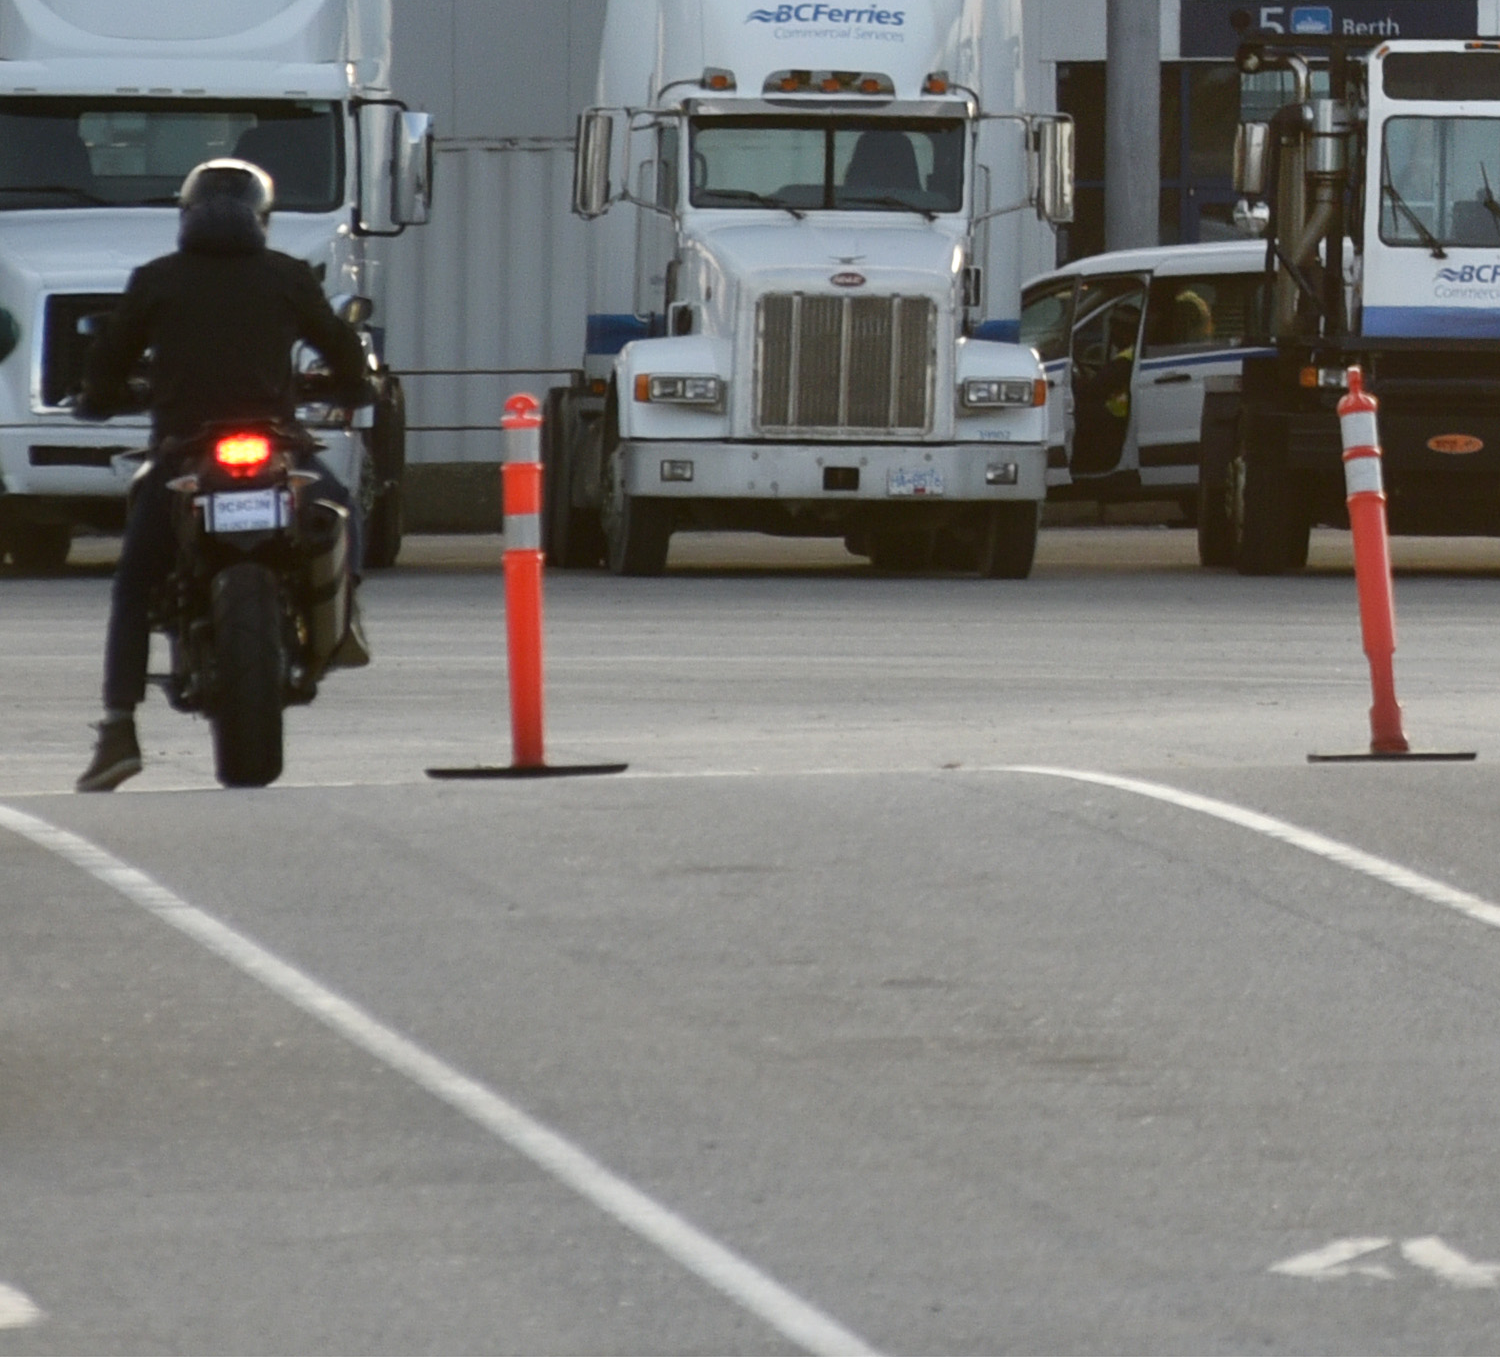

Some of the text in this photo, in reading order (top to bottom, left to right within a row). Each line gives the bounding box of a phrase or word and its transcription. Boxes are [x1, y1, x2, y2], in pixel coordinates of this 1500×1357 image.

[773, 3, 906, 26] BCFerries
[774, 27, 904, 43] Commercial Services
[1342, 17, 1400, 35] Berth
